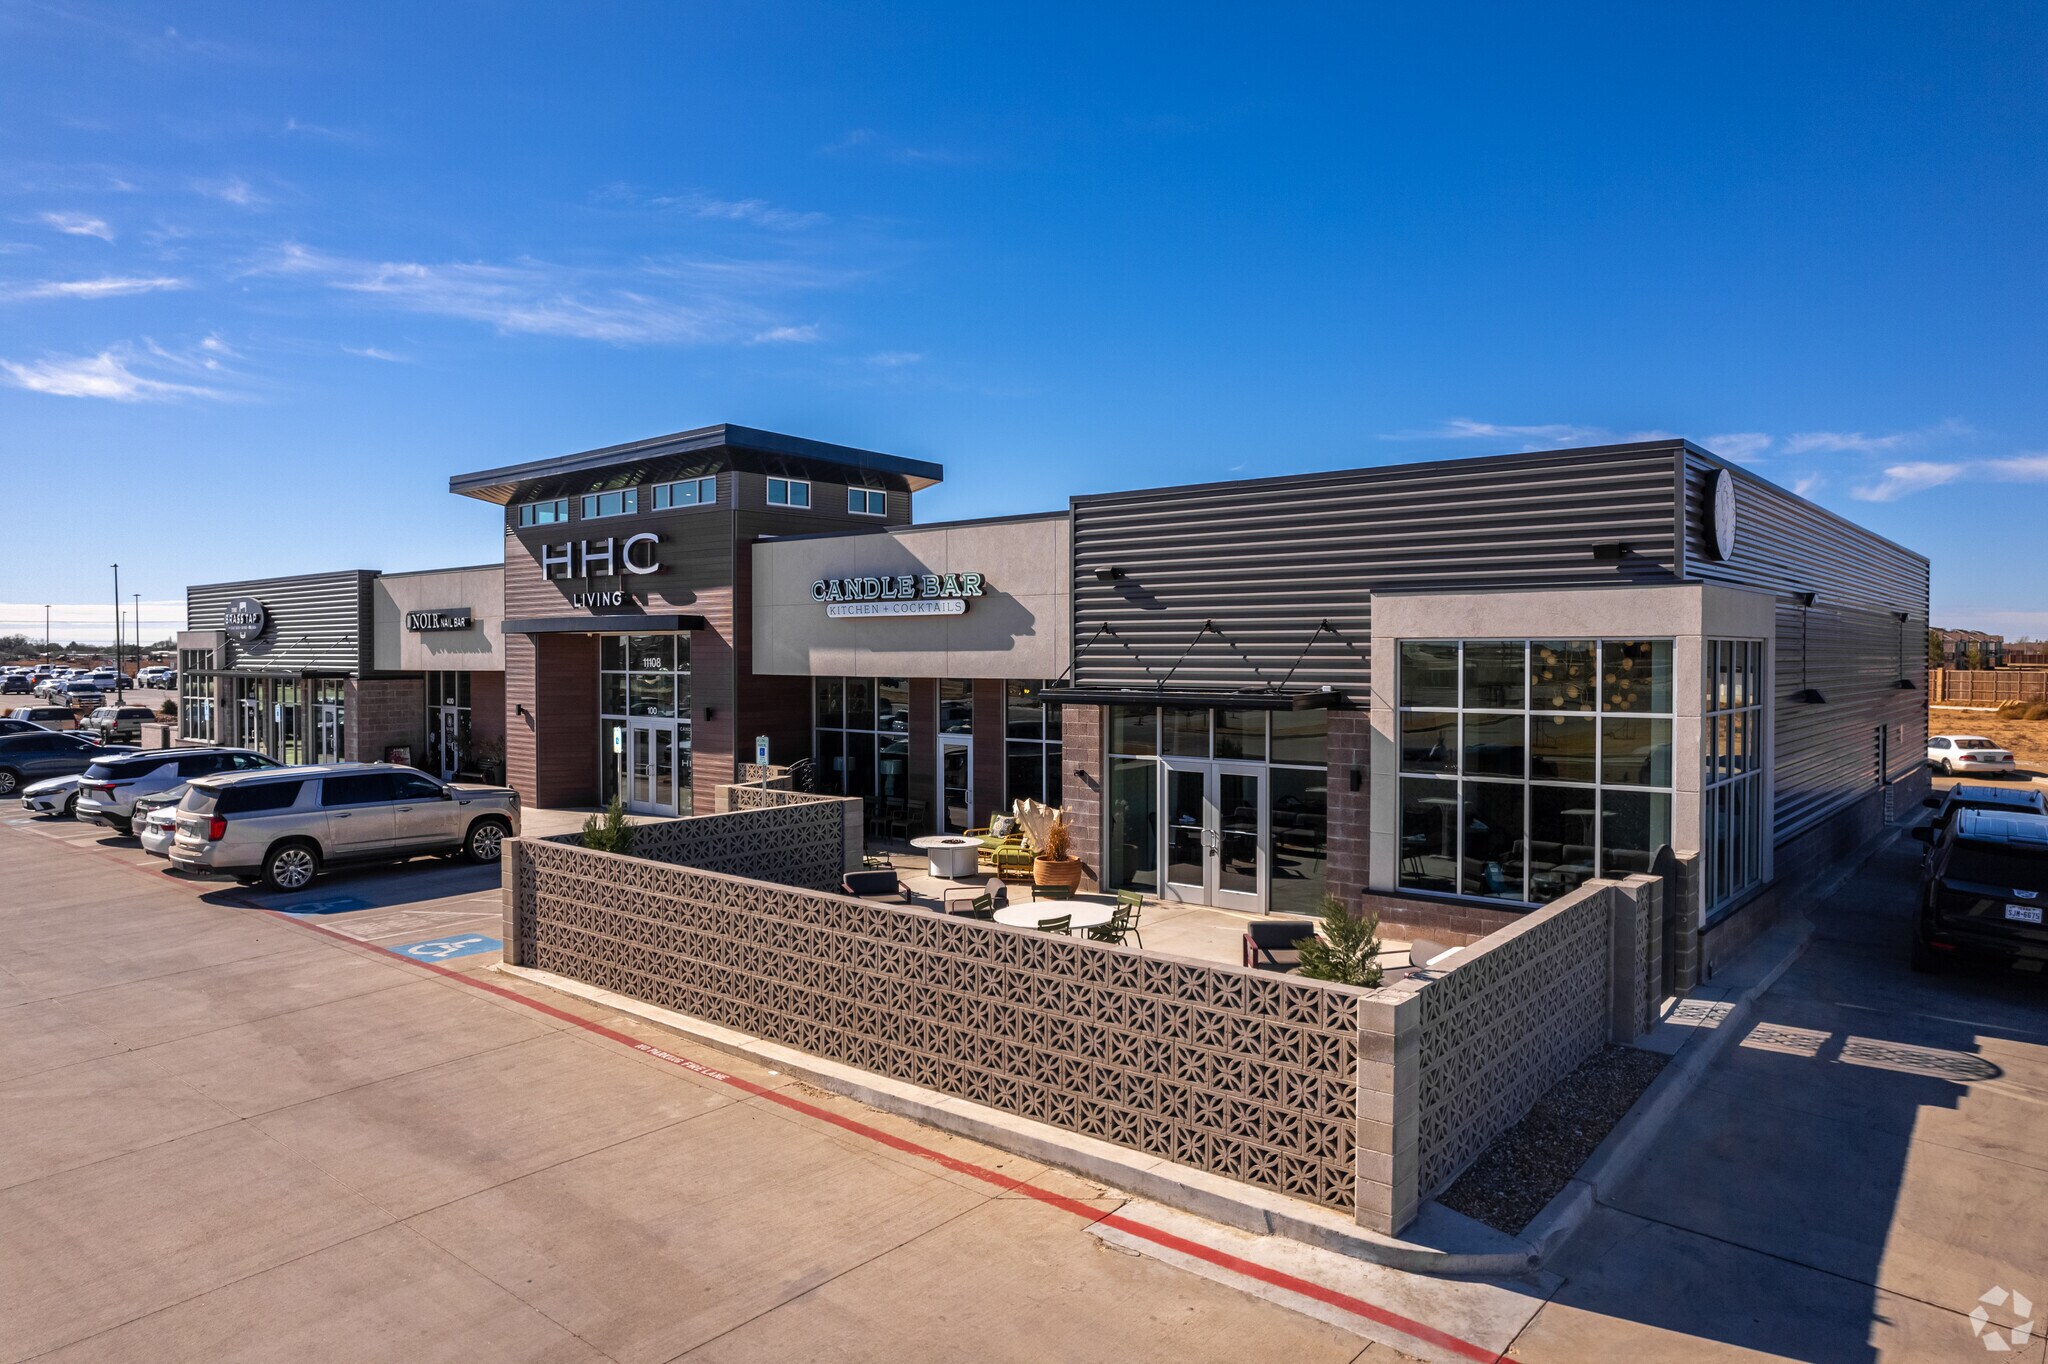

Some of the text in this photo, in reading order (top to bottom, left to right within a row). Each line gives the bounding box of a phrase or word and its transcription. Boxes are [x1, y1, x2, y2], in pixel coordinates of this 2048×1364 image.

[542, 532, 660, 581] HHC
[811, 571, 983, 602] CANDLE BAR
[573, 591, 622, 608] LIVING
[829, 604, 879, 616] KITCHEN
[893, 601, 963, 613] COCKTAILS
[225, 612, 257, 625] BRASS TAP
[412, 612, 466, 629] NOIR NAIL BAR
[642, 657, 662, 668] 11108
[647, 706, 658, 715] 100
[634, 1043, 731, 1081] NO PARKING FIRE LANE
